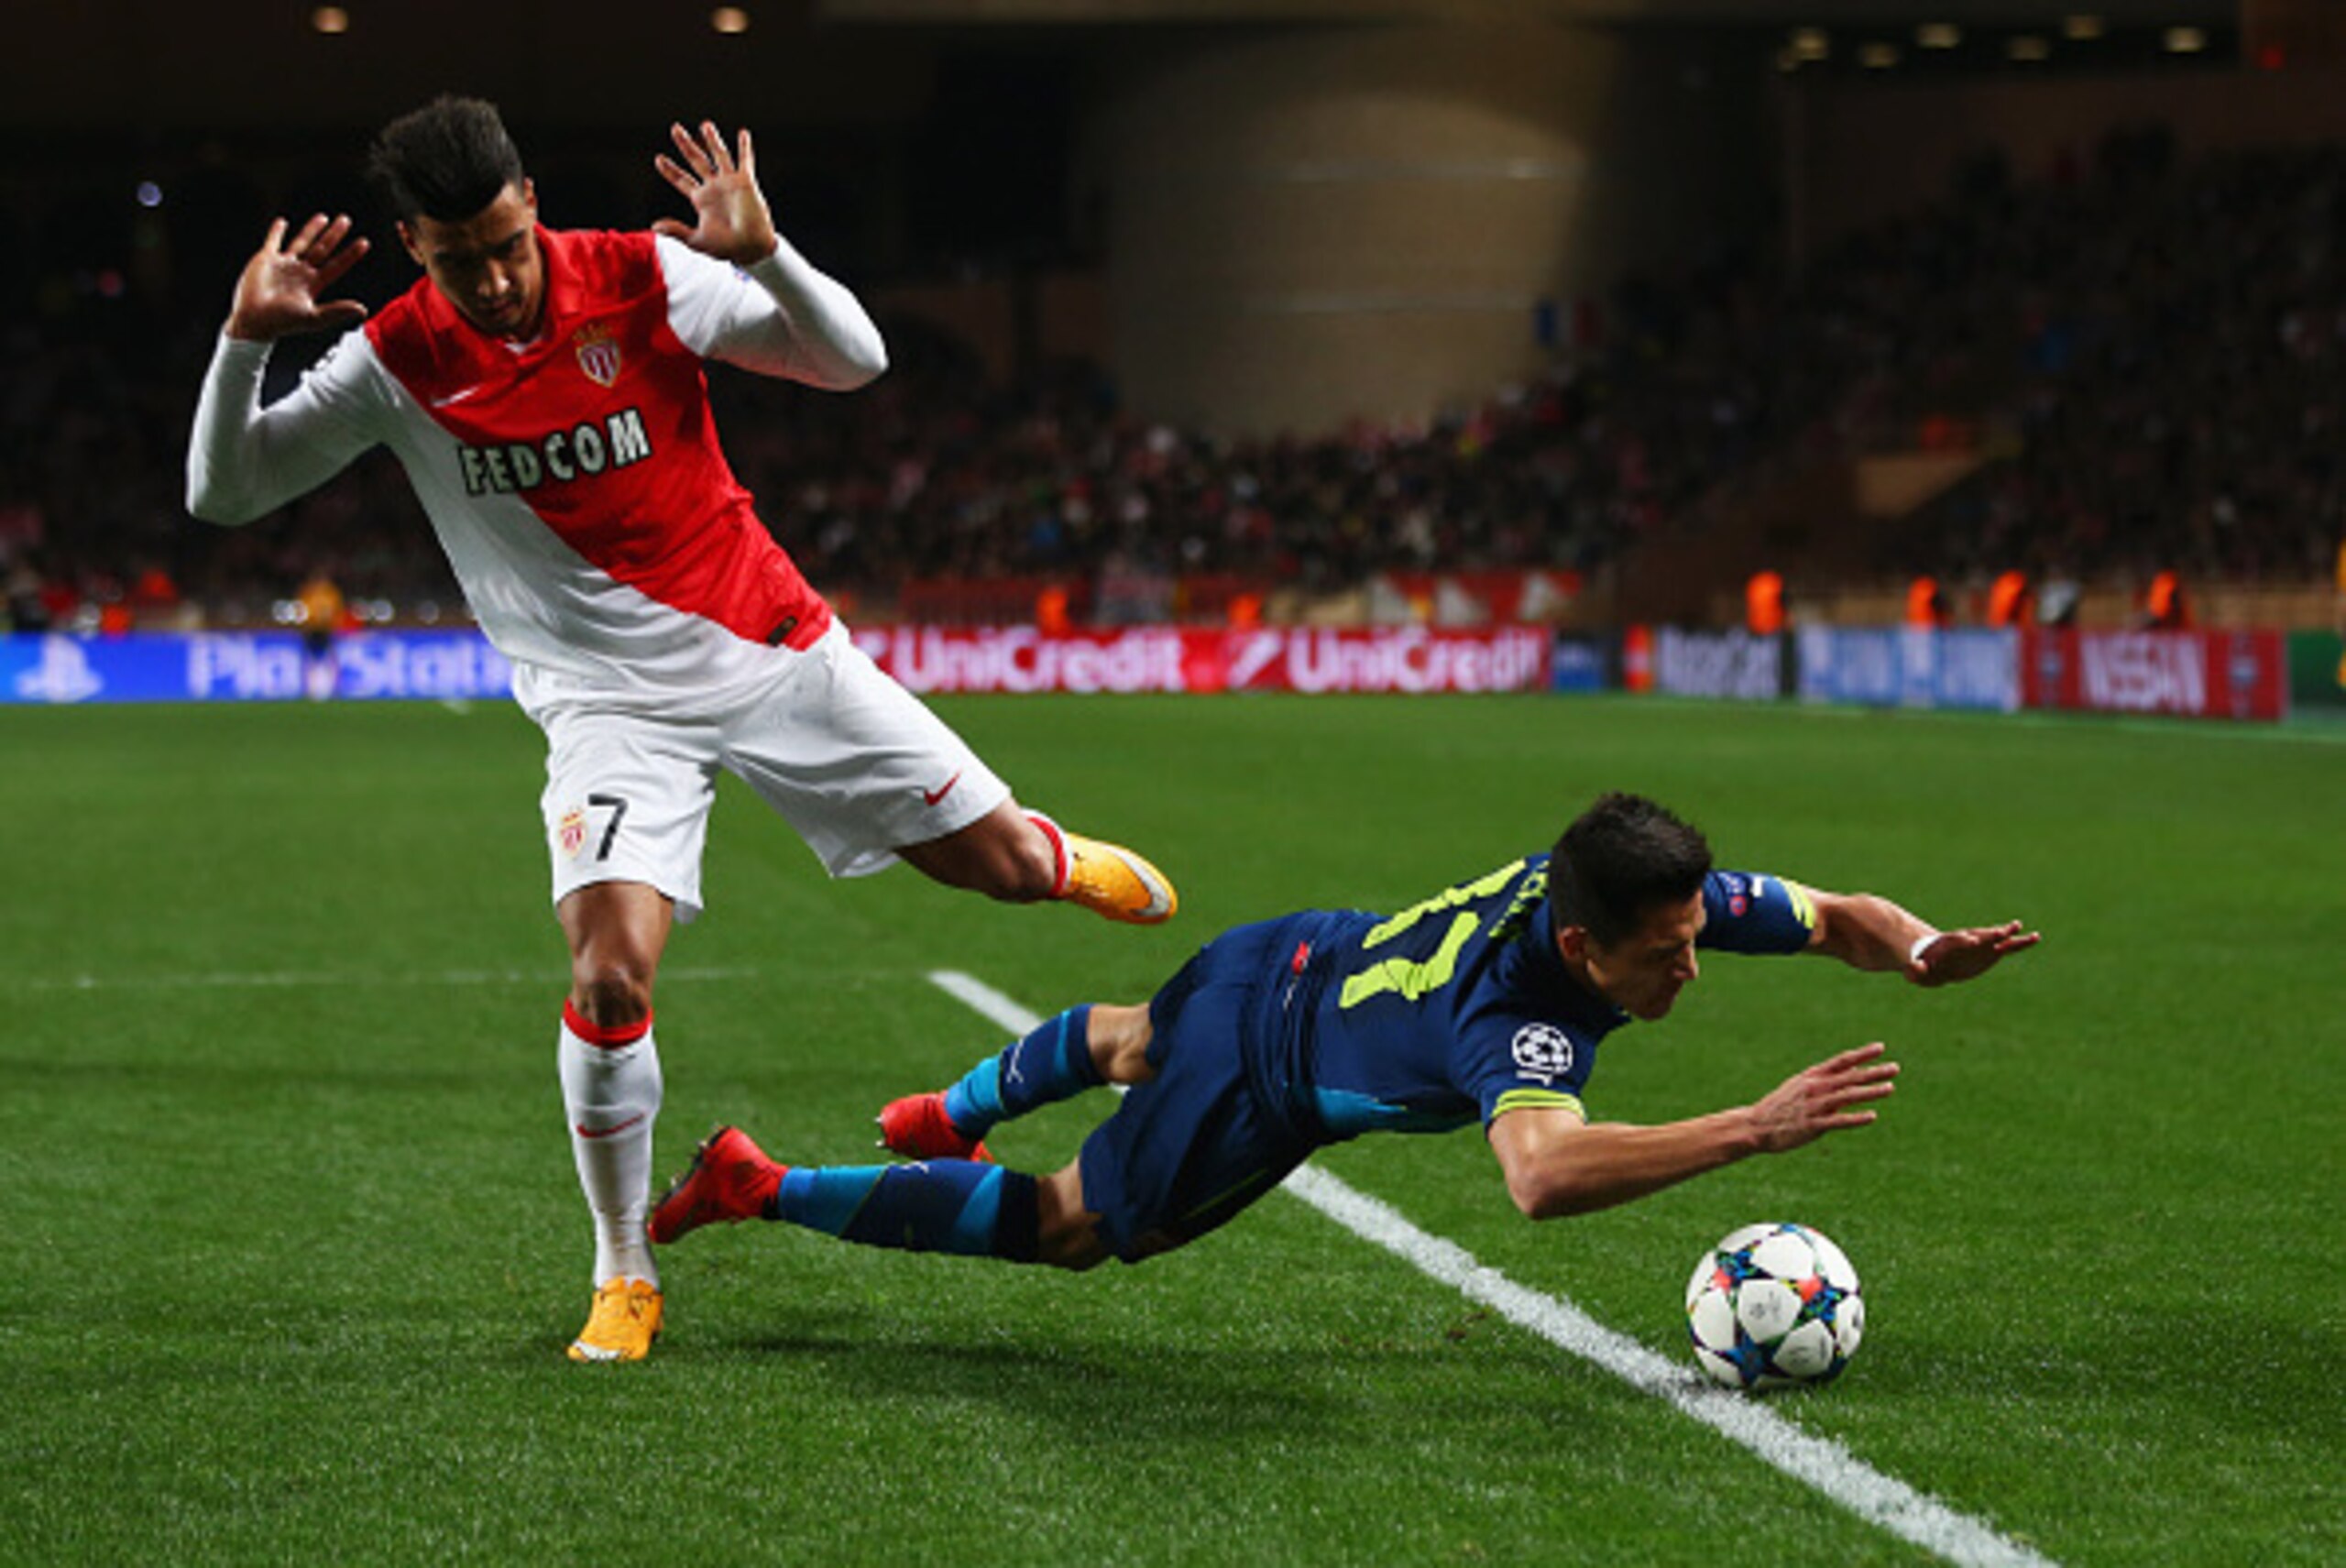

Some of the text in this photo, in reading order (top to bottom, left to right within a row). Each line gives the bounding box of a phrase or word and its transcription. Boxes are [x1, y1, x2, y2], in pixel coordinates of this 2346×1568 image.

[459, 406, 652, 498] FEDCOM
[892, 627, 1186, 694] UniCredit
[1289, 627, 1540, 692] UniCredit
[587, 794, 628, 861] 7
